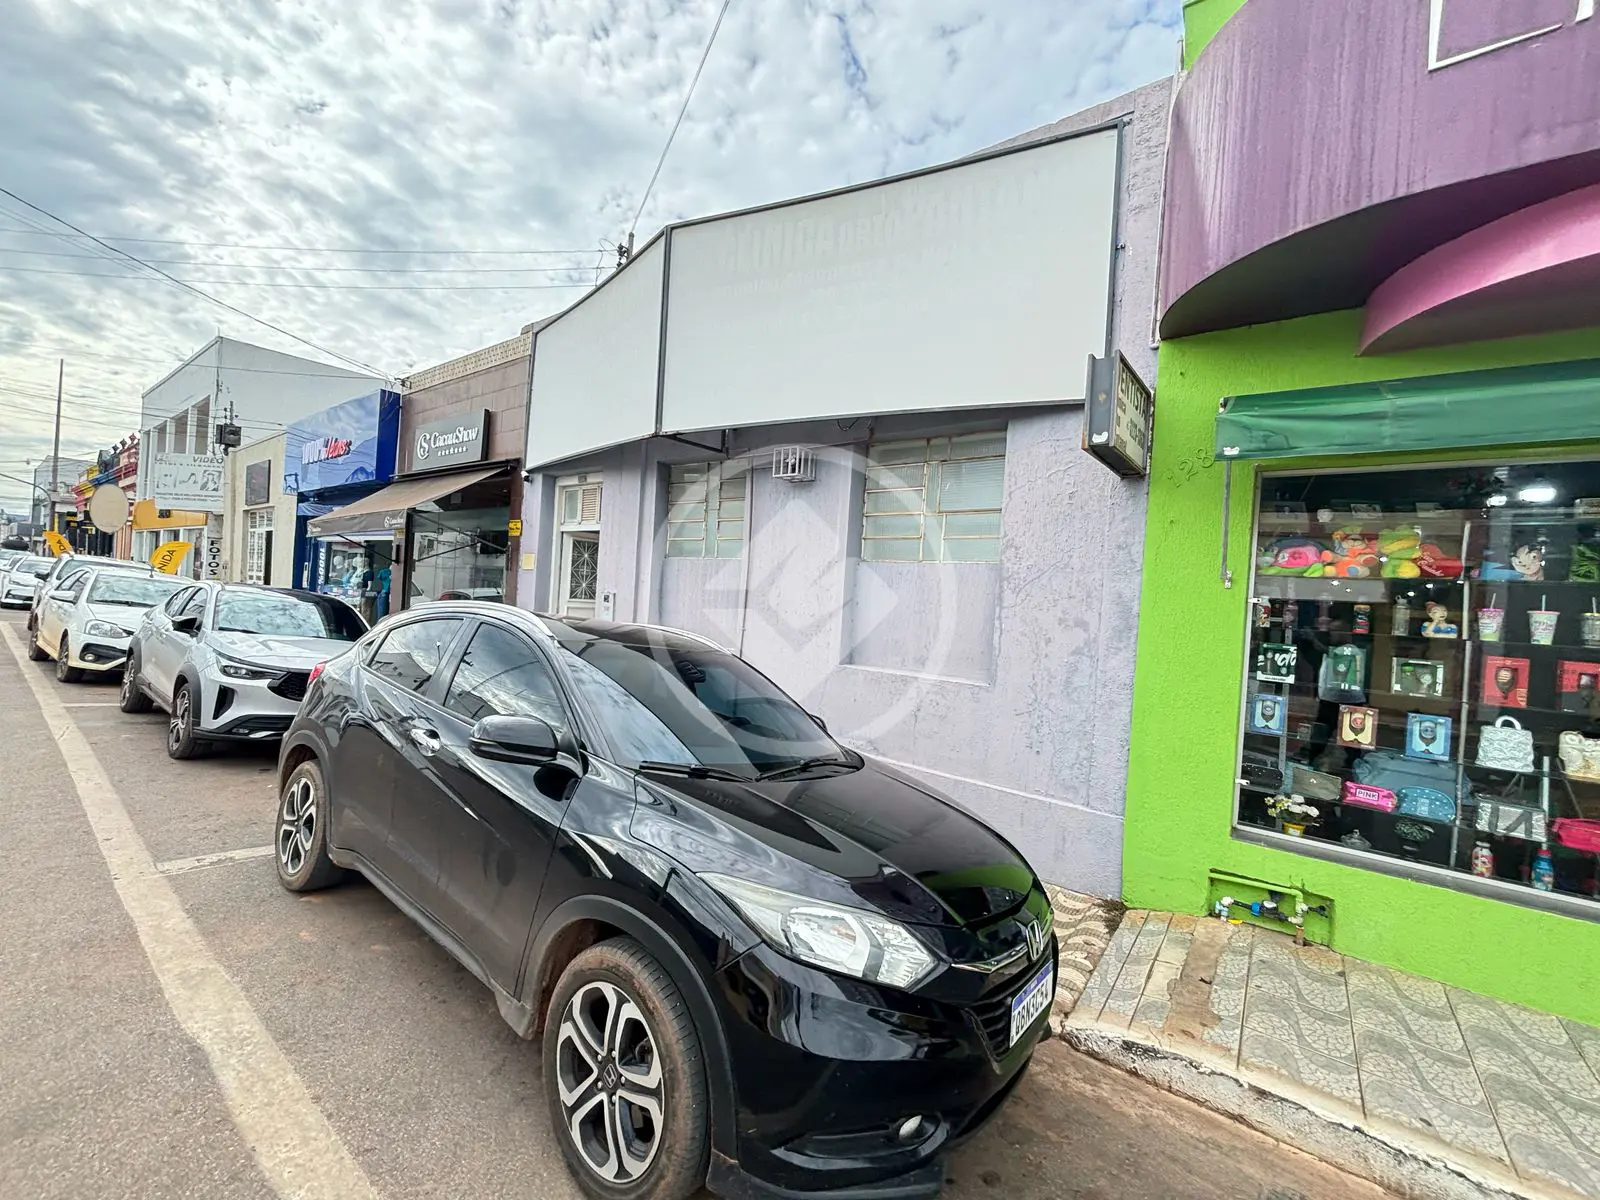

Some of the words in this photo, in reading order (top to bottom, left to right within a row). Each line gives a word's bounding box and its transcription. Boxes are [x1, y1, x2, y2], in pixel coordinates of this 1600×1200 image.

[158, 549, 176, 573] NIDA
[208, 540, 220, 576] FOTOS
[1357, 789, 1377, 799] PINK
